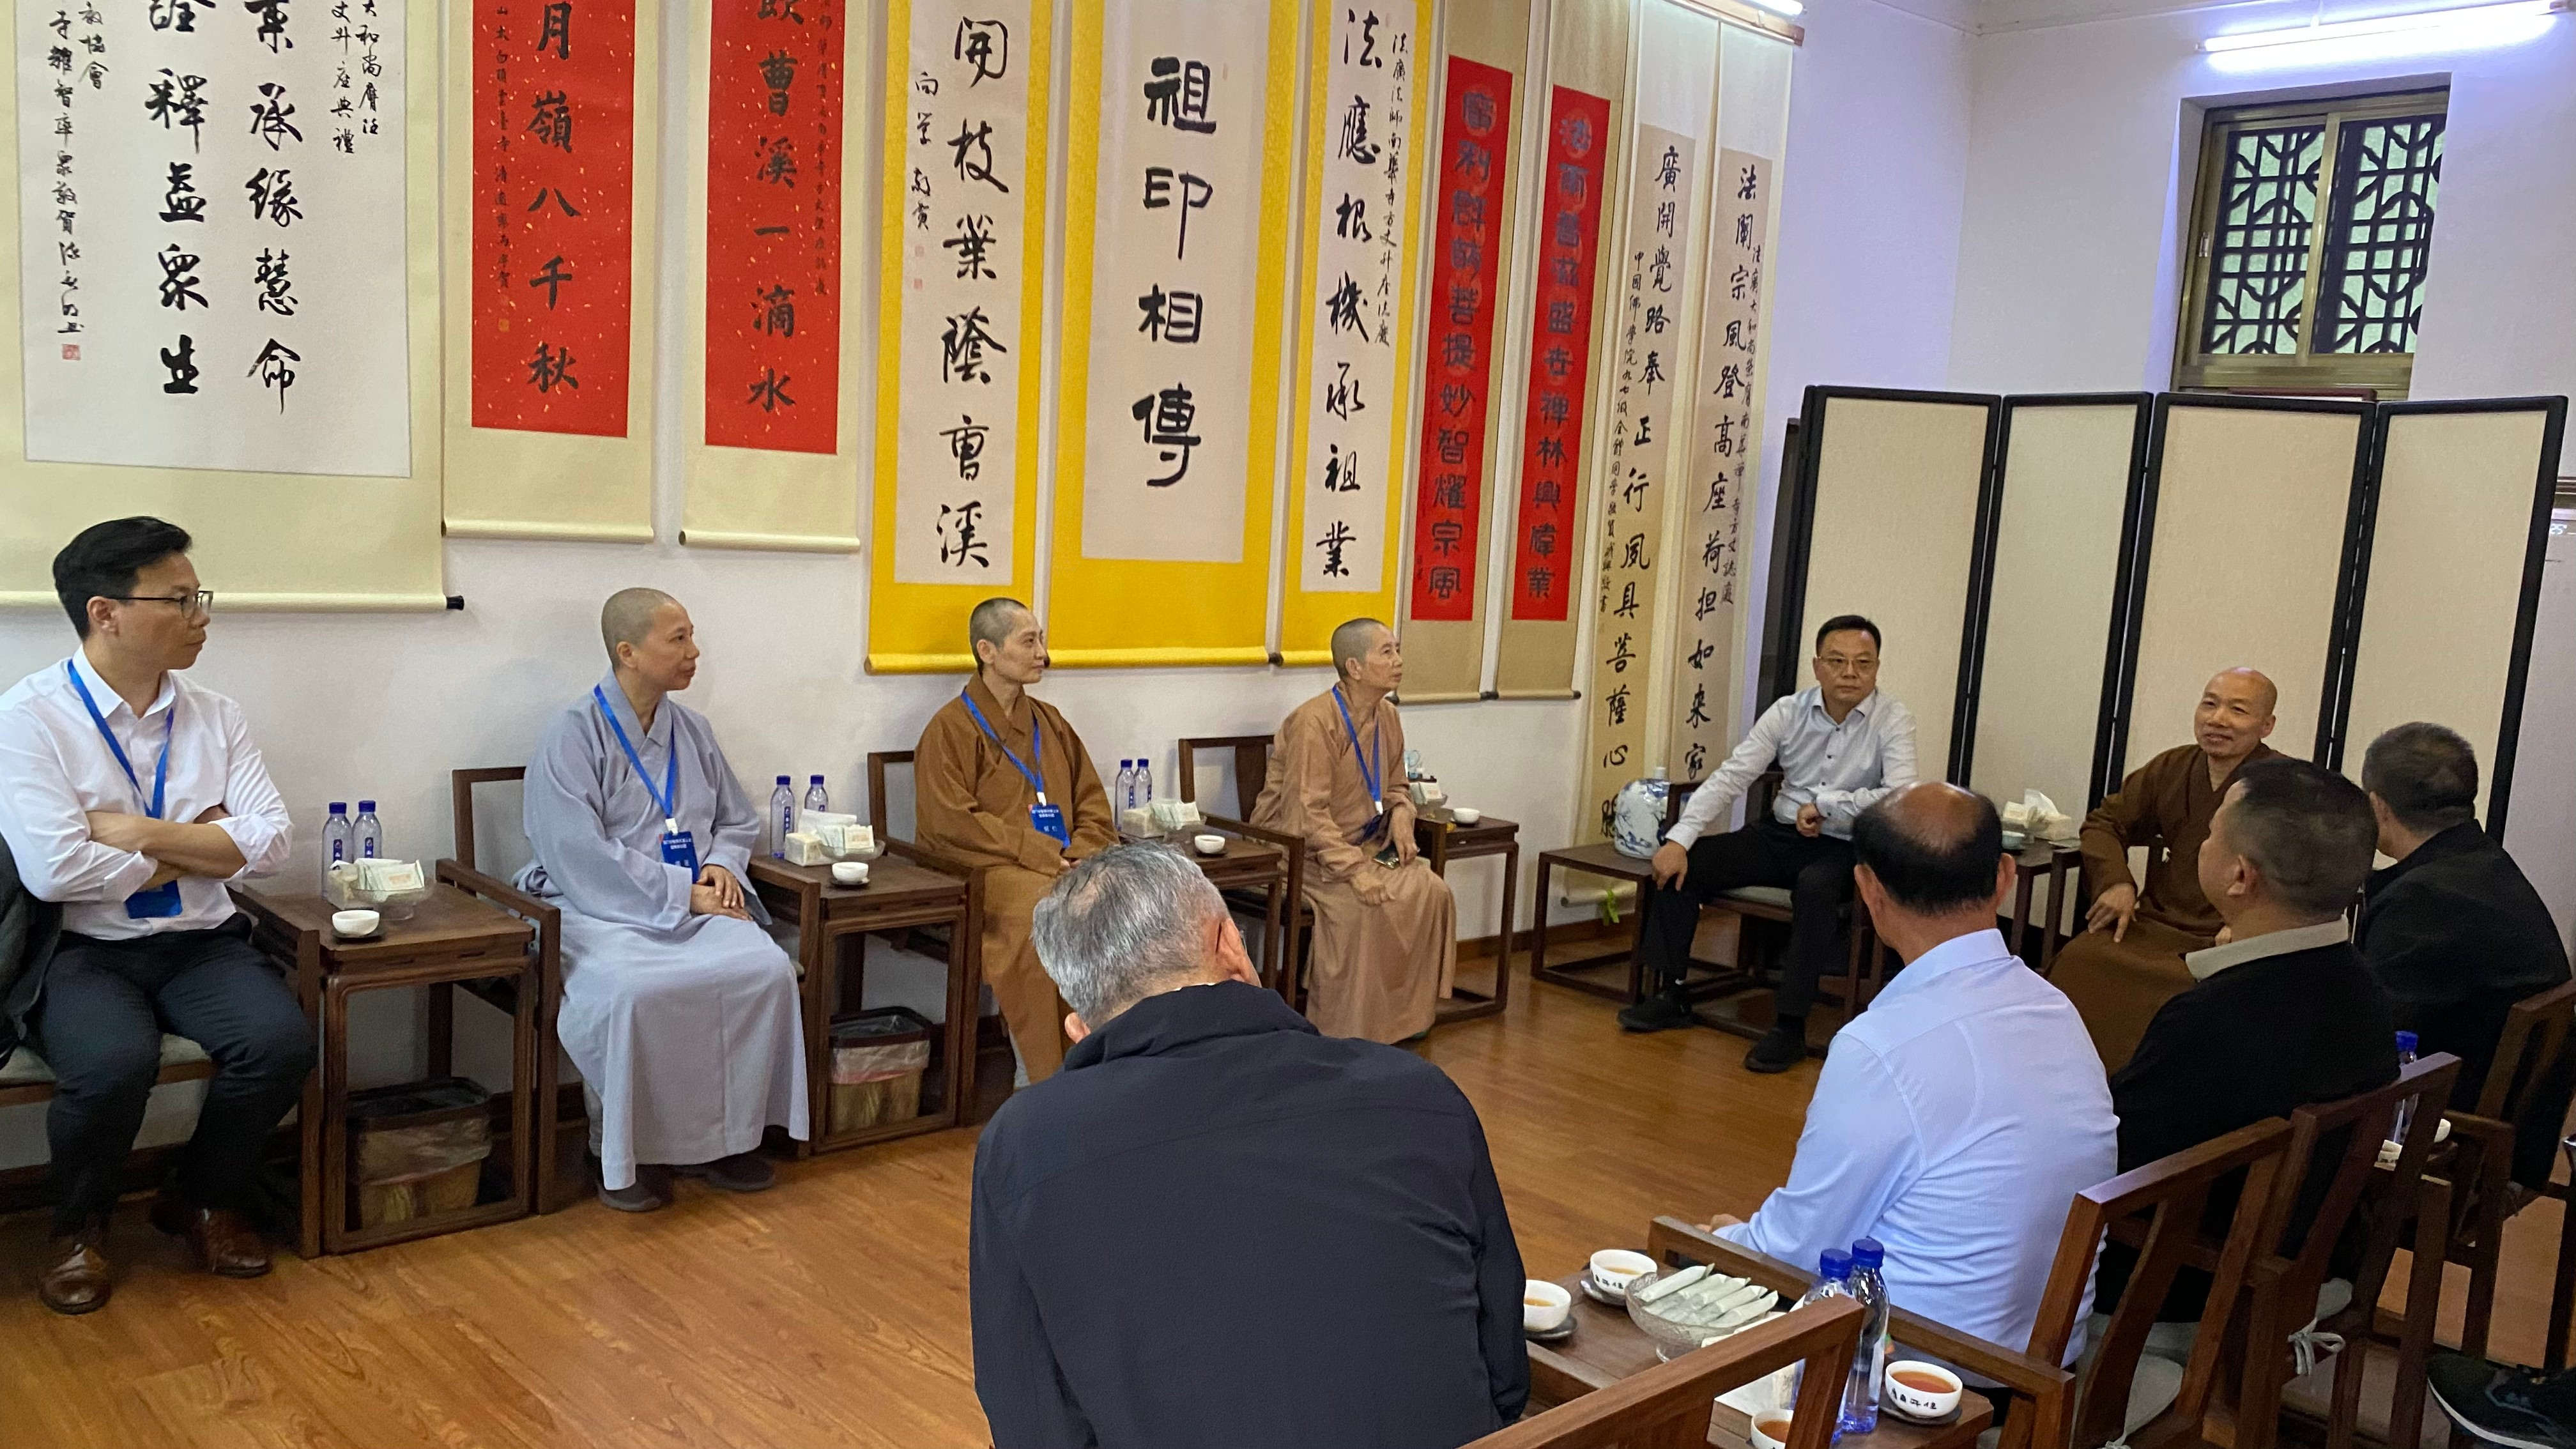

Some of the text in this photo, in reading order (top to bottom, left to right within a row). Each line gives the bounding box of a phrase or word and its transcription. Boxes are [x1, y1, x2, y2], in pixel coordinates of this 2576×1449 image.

[526, 3, 581, 394] 月嶺八千秋
[1132, 56, 1216, 488] 祖印相傳
